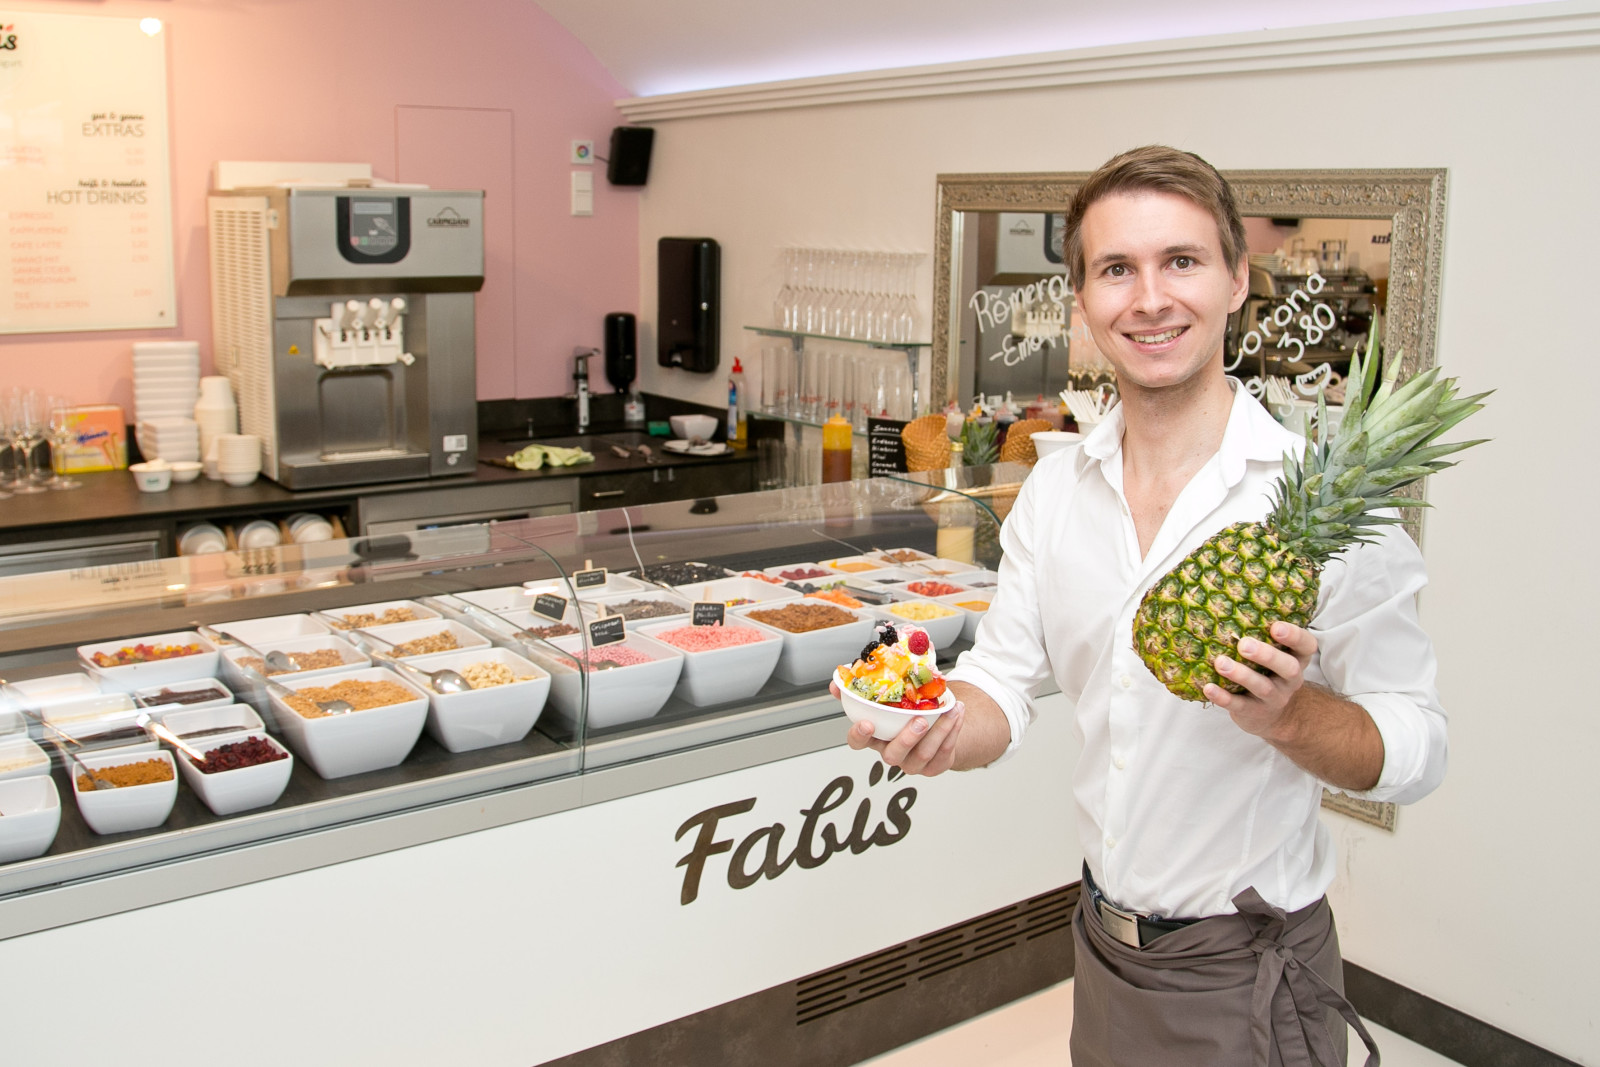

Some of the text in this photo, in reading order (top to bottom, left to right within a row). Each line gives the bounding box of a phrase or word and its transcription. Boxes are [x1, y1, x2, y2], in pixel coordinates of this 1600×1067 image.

[82, 122, 144, 138] EXTRAS
[46, 190, 147, 205] HOT DRINKS
[1277, 303, 1336, 363] 3.80
